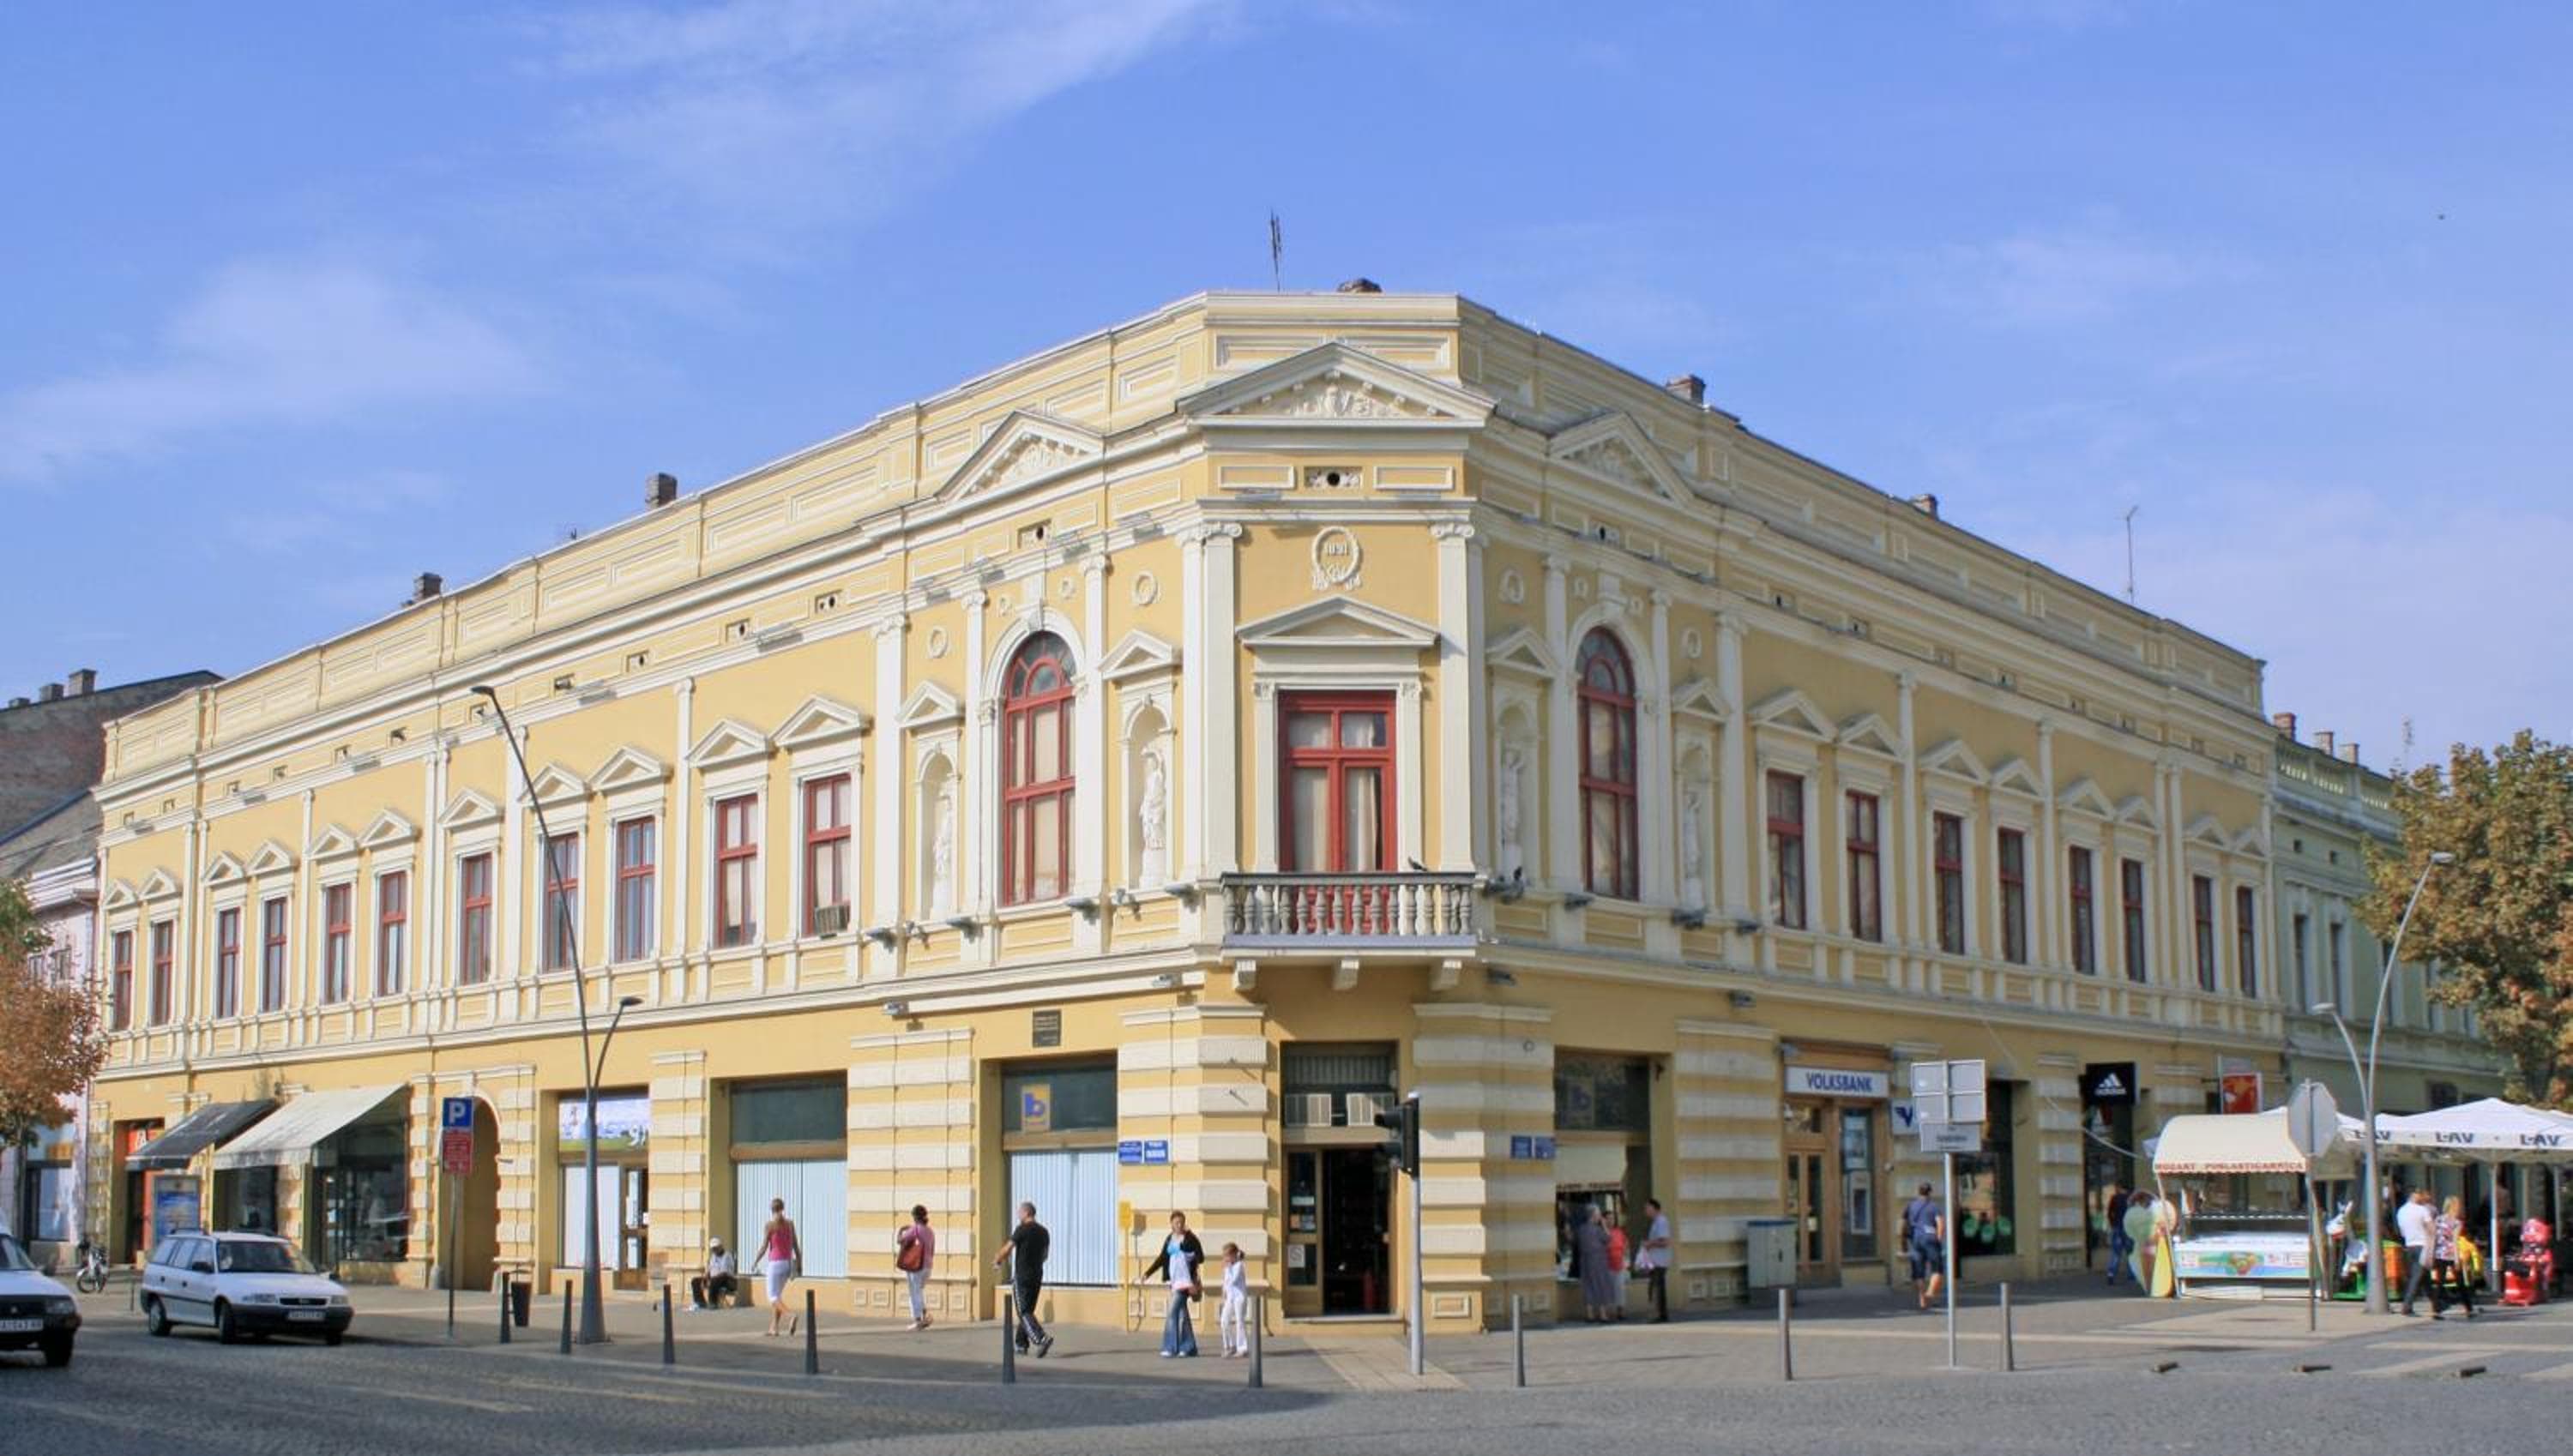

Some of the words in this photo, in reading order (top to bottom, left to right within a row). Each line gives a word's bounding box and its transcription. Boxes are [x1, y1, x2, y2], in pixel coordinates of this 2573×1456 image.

[1805, 1073, 1872, 1092] VOLKSBANK
[449, 1102, 467, 1123] P
[2155, 1162, 2196, 1171] MOZART
